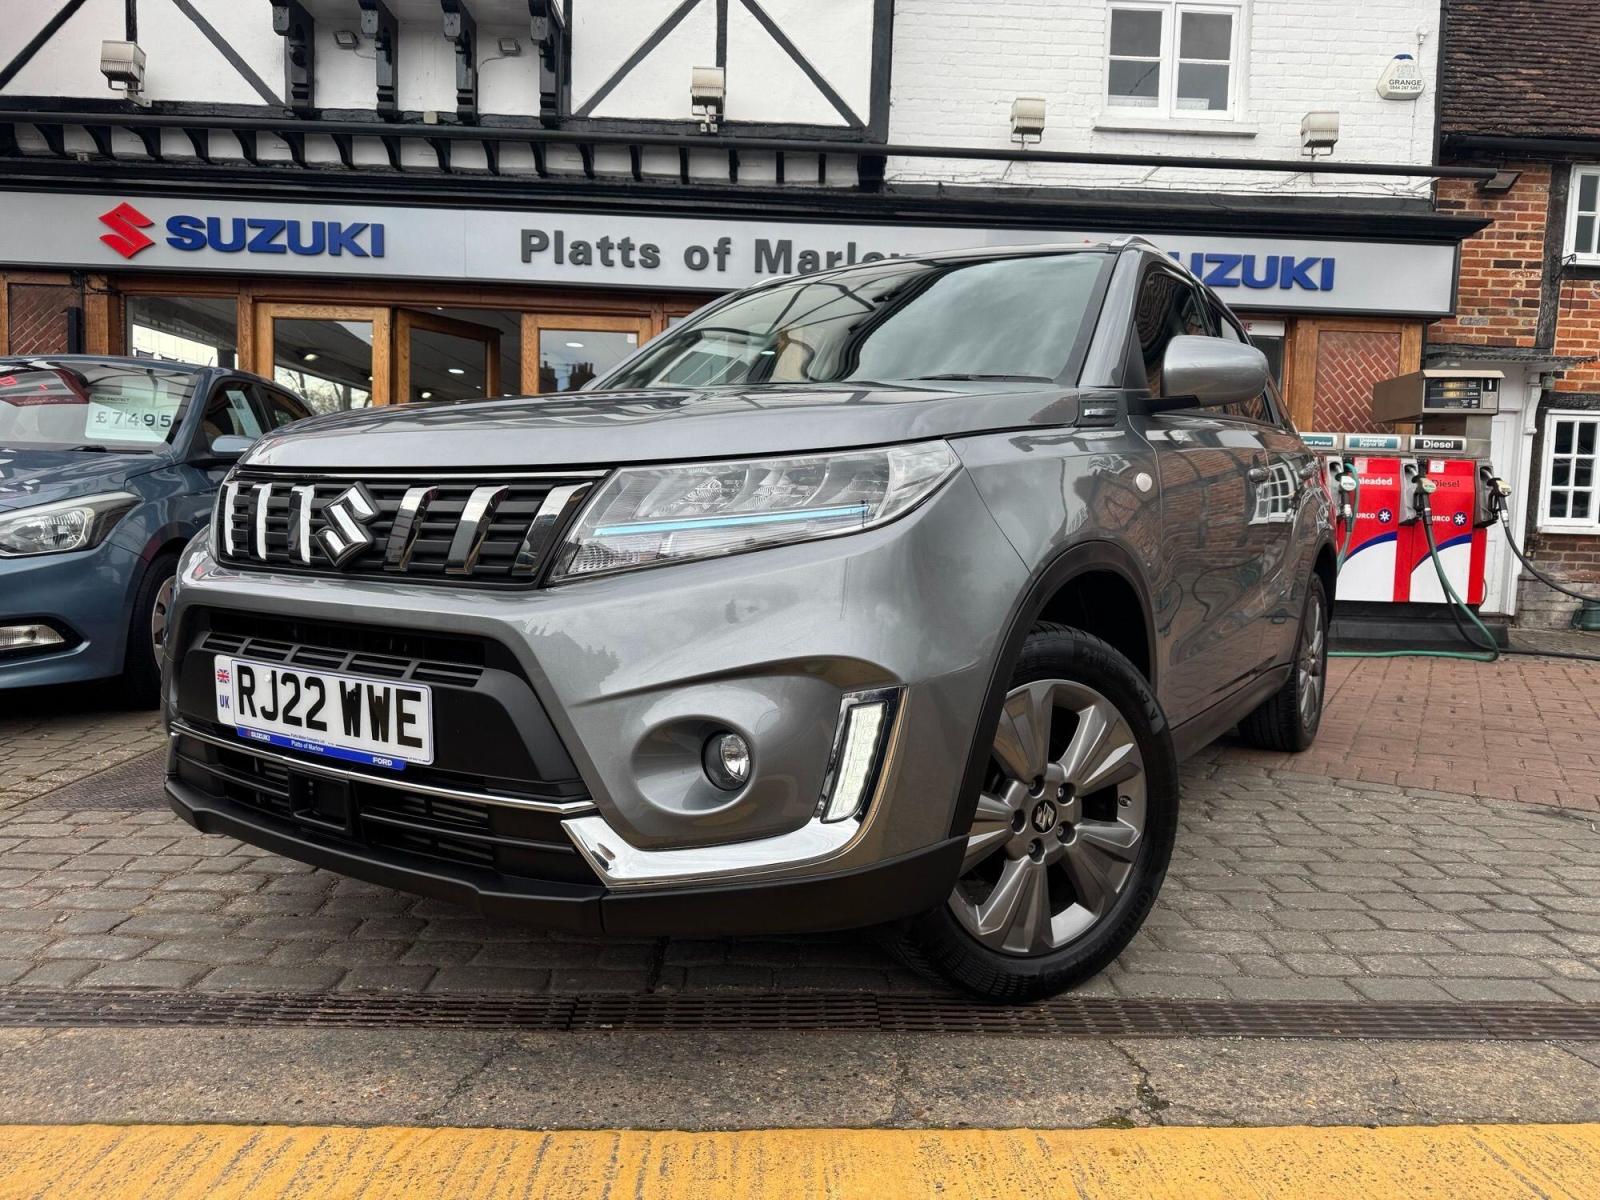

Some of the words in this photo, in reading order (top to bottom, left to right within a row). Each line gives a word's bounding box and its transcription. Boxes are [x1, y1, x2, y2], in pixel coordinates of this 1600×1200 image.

[165, 214, 385, 257] SUZUKI
[520, 228, 661, 269] Platts
[683, 236, 732, 272] of
[754, 238, 904, 275] Marl
[1167, 251, 1336, 292] UZUKI
[95, 411, 172, 428] £7495
[1423, 440, 1454, 449] Diesel
[1358, 477, 1393, 486] nleaded
[1431, 479, 1460, 488] Diesel
[219, 694, 230, 709] UK
[236, 664, 328, 732] RJ22
[338, 680, 423, 749] WWE
[250, 731, 271, 742] SUZUKI
[372, 756, 392, 767] FORD
